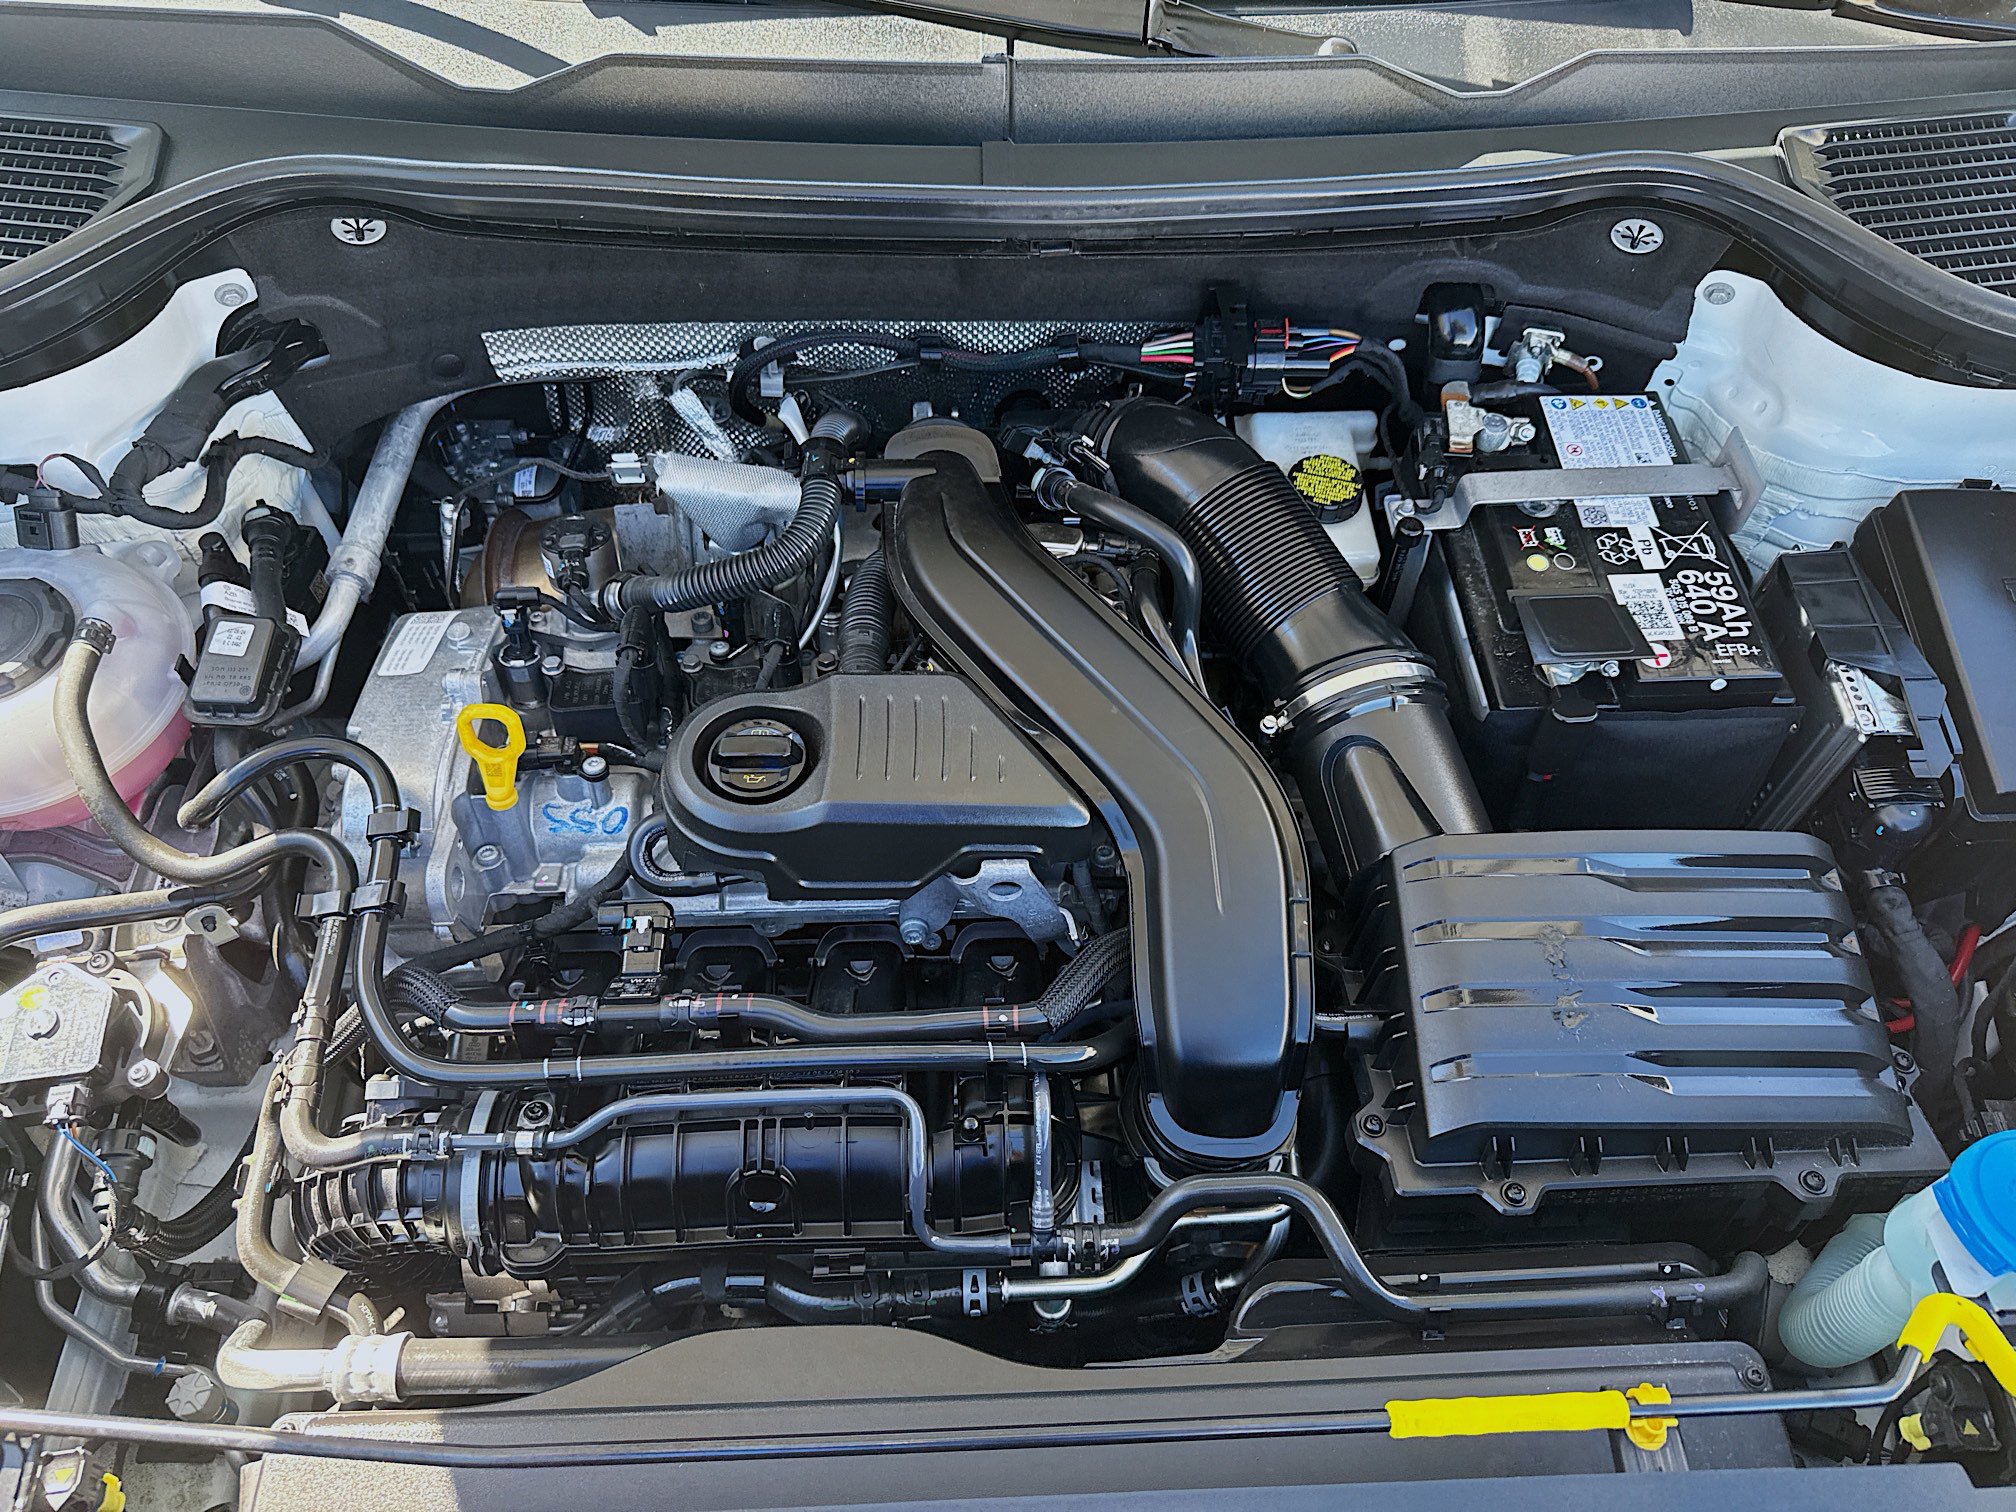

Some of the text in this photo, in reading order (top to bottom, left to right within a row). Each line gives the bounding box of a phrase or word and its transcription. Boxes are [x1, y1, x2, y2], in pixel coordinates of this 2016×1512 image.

[1638, 539, 1653, 555] Pb
[1677, 570, 1718, 615] 640
[1704, 571, 1753, 637] 59Ah
[1697, 621, 1729, 642] A
[1714, 643, 1761, 657] EFB+
